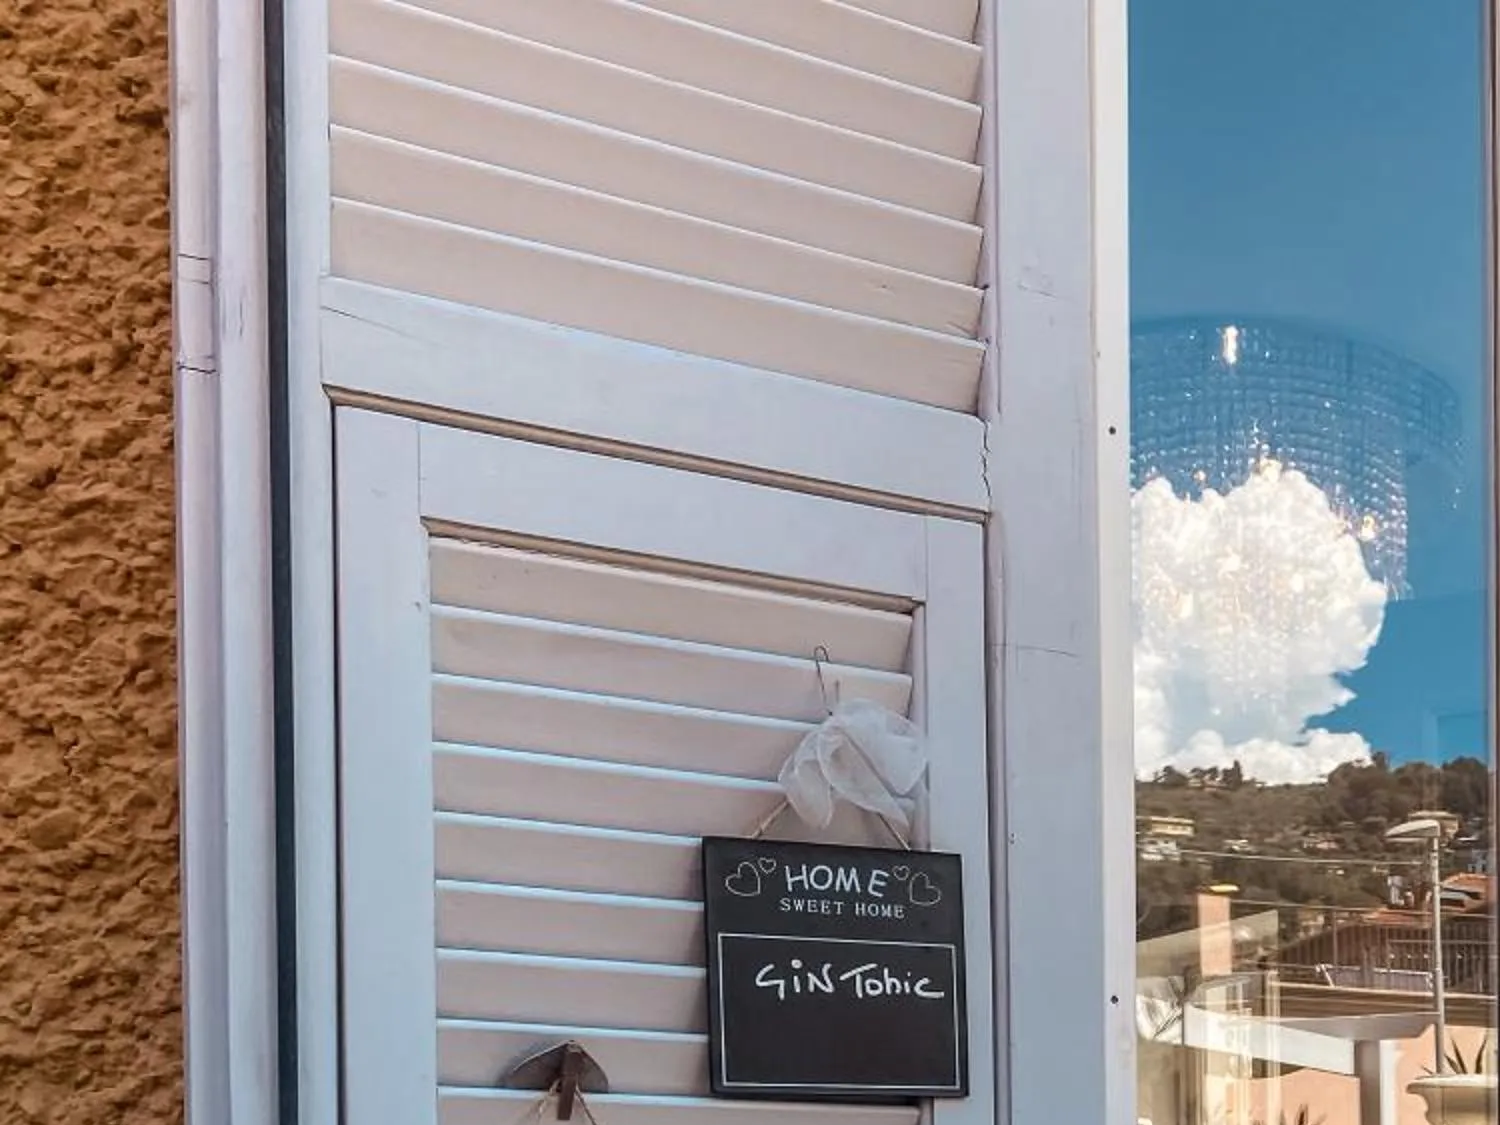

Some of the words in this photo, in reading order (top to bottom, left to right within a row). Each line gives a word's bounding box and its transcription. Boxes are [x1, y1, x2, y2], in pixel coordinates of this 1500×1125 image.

[784, 864, 889, 897] HOME
[780, 898, 844, 915] SWEET
[855, 904, 905, 918] HOME
